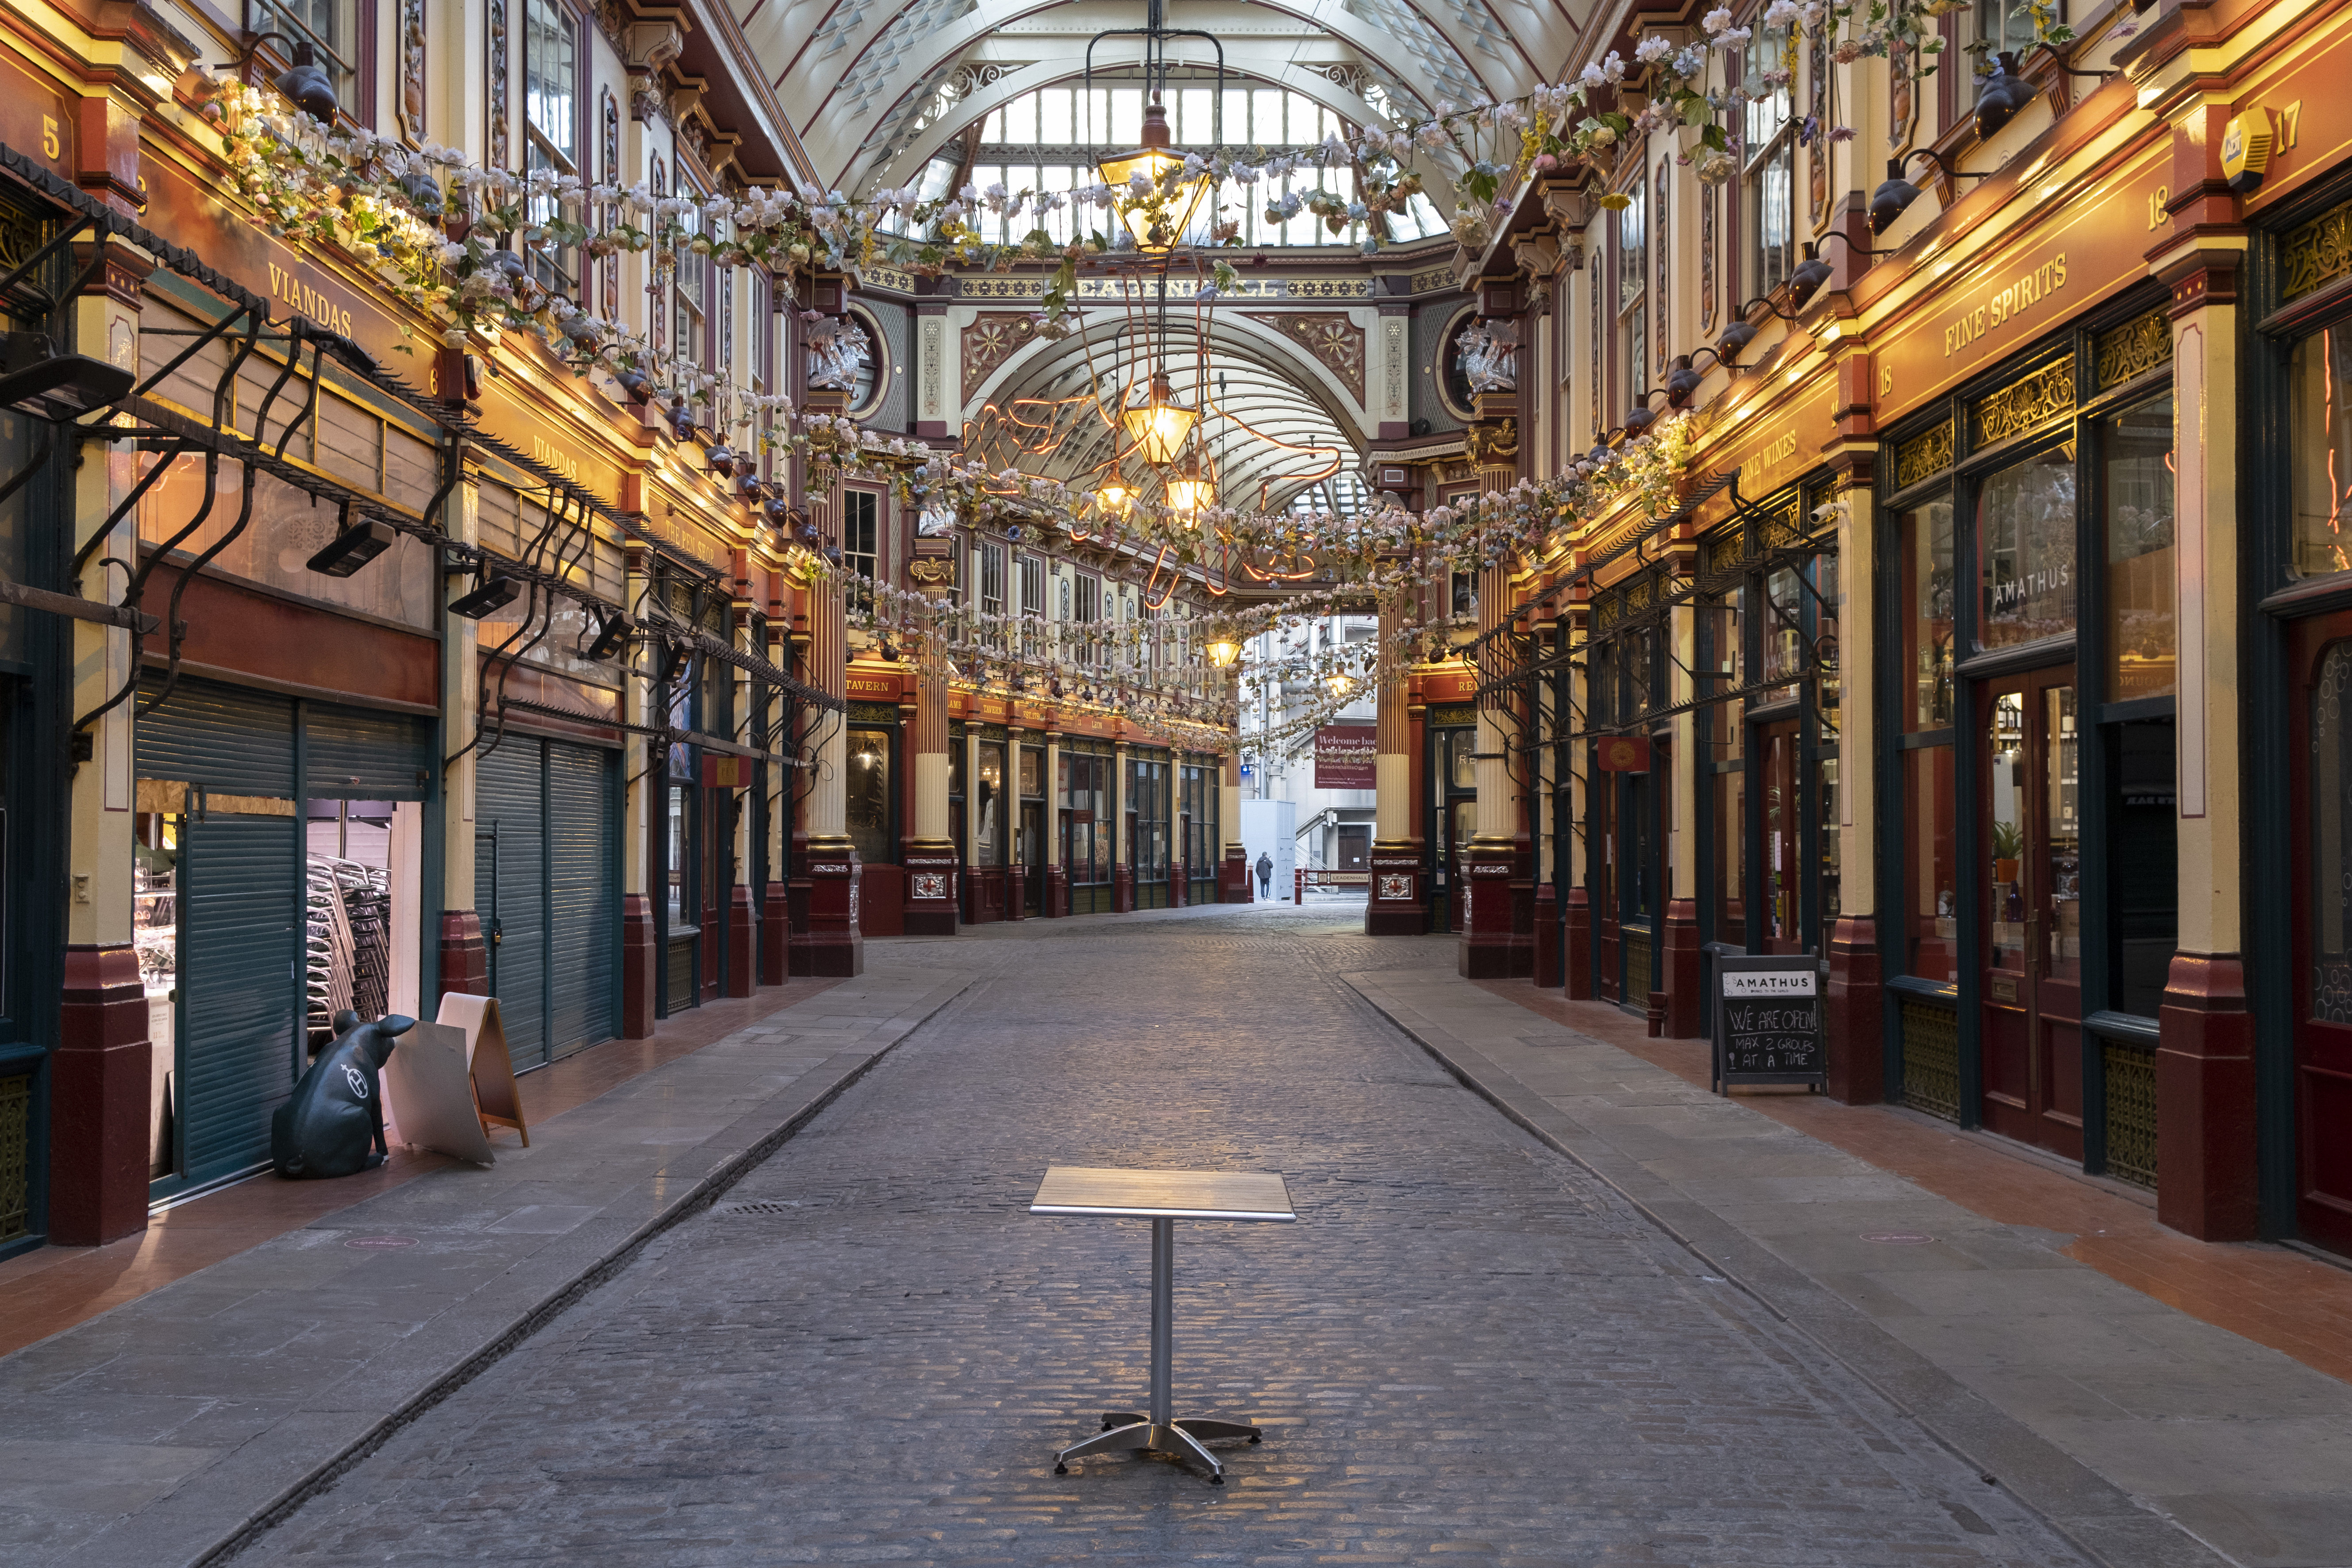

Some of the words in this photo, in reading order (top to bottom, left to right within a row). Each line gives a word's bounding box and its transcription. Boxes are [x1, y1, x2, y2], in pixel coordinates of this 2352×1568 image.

[43, 114, 59, 159] 5
[2275, 99, 2301, 155] 17
[2226, 135, 2241, 158] ADT
[2148, 185, 2167, 231] 18
[269, 262, 351, 339] VIANDAS
[1063, 279, 1278, 297] EADENHLL
[1945, 304, 1986, 357] FINE
[1991, 252, 2067, 328] SPIRITS
[430, 367, 438, 395] 6
[1881, 365, 1892, 396] 18
[534, 435, 577, 482] VIANDAS
[1763, 429, 1796, 469] WINES
[666, 520, 680, 546] THE
[682, 530, 695, 555] PEN
[698, 541, 714, 566] SHOP
[1995, 564, 2068, 605] AMATHUS
[846, 680, 889, 691] TAVERN
[948, 700, 962, 709] AMB
[983, 705, 1002, 714] TAVERN
[1092, 721, 1102, 729] LEON
[1318, 735, 1360, 744] Welcome
[1736, 978, 1808, 987] AMATHUS
[1726, 1006, 1754, 1030] WE
[1759, 1010, 1780, 1030] ARE
[1782, 1001, 1817, 1032] OPEN!
[1736, 1037, 1759, 1049] MAX
[1766, 1038, 1775, 1050] 2
[1778, 1038, 1815, 1052] GROUPS
[1743, 1054, 1758, 1067] AT
[1768, 1055, 1775, 1067] A
[1784, 1052, 1808, 1065] TIME
